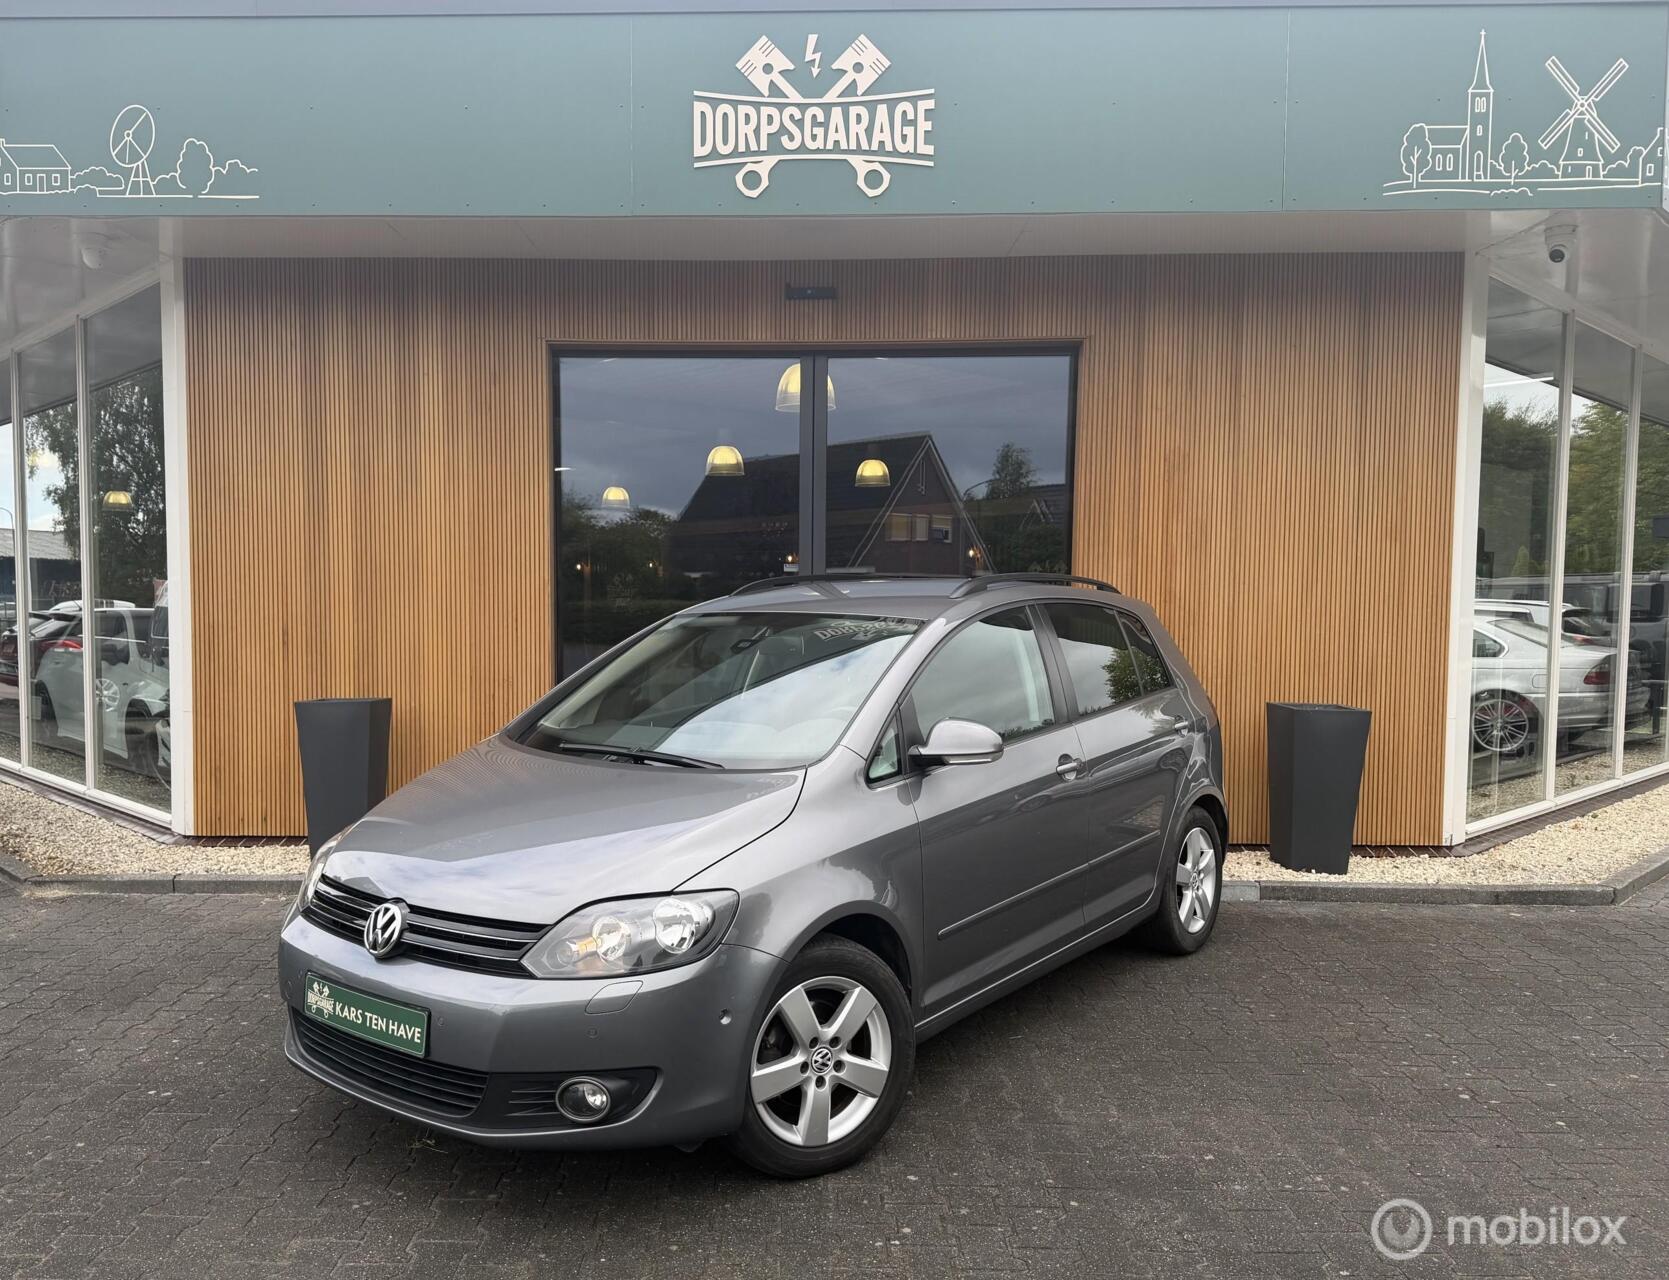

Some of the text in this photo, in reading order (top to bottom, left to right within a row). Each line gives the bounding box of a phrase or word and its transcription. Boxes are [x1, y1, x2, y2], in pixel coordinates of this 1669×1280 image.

[693, 99, 935, 158] DORPSGARAGE
[335, 1001, 422, 1043] KARS TEN HAVE
